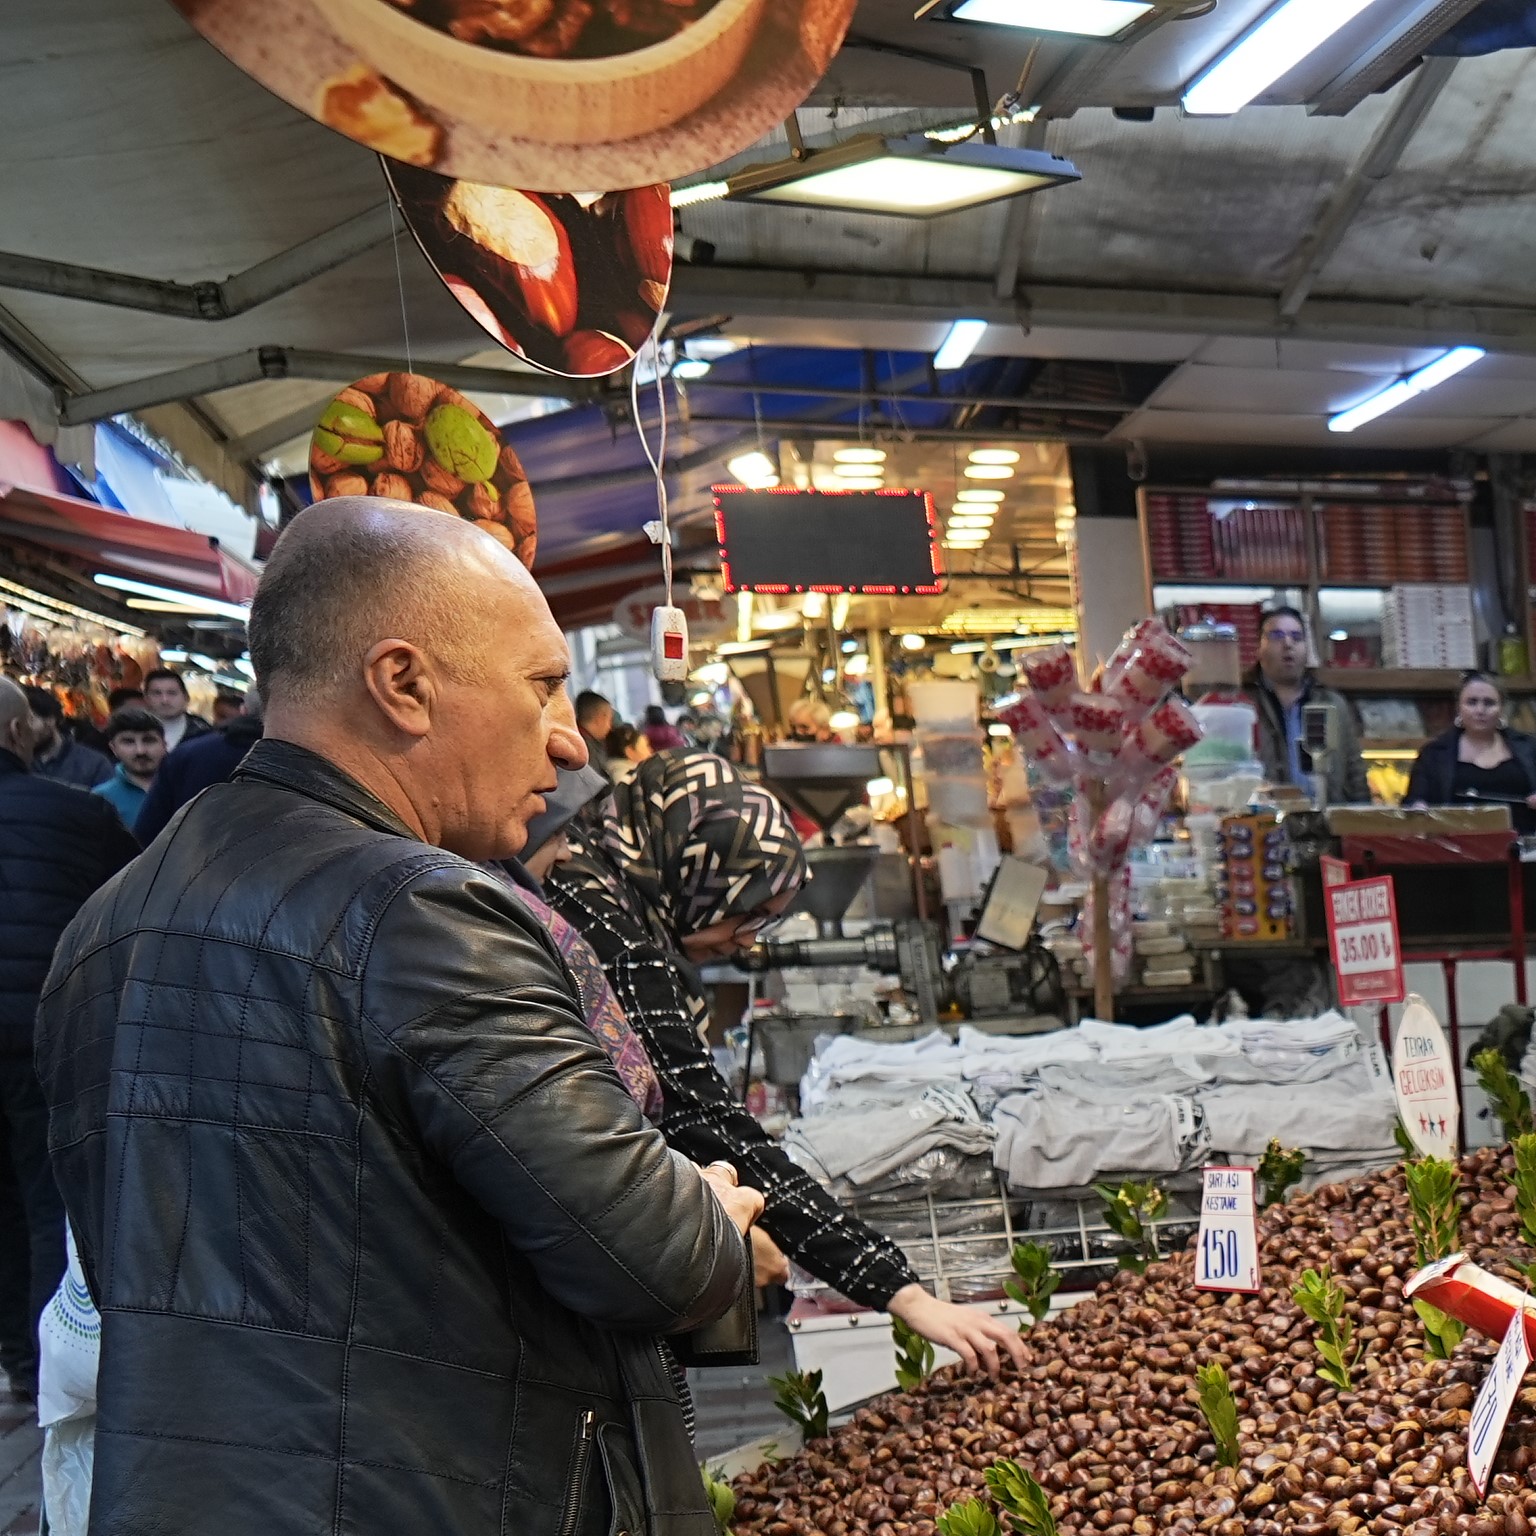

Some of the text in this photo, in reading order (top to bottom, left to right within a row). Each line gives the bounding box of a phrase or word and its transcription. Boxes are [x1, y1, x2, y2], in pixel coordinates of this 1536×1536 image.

[1340, 934, 1379, 963] 35.00
[1205, 1196, 1238, 1211] KESTANE
[1202, 1228, 1238, 1280] 150
